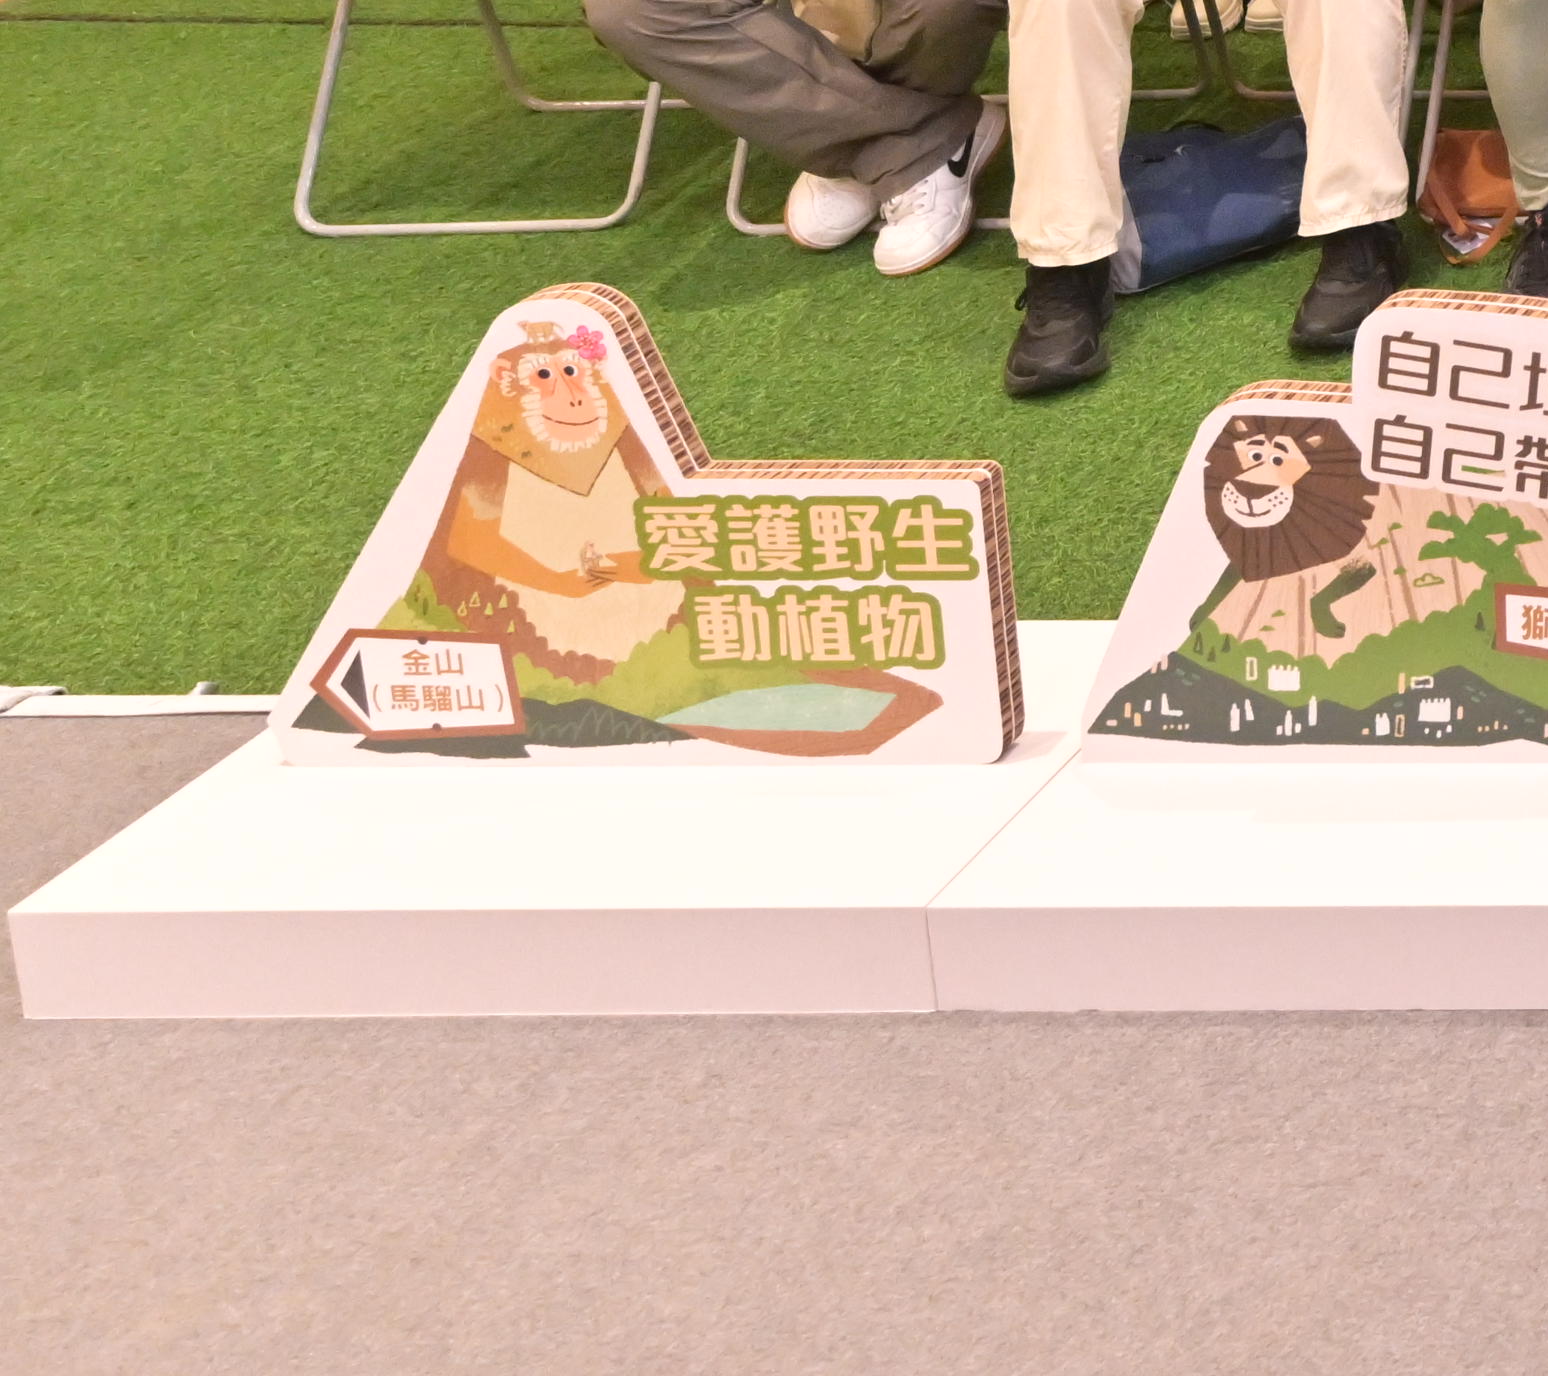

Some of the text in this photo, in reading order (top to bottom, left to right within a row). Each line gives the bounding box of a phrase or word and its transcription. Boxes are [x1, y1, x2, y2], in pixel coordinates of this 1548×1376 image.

[642, 503, 973, 575] 愛護野生
[401, 649, 465, 677] 金山
[697, 593, 938, 663] 動植物
